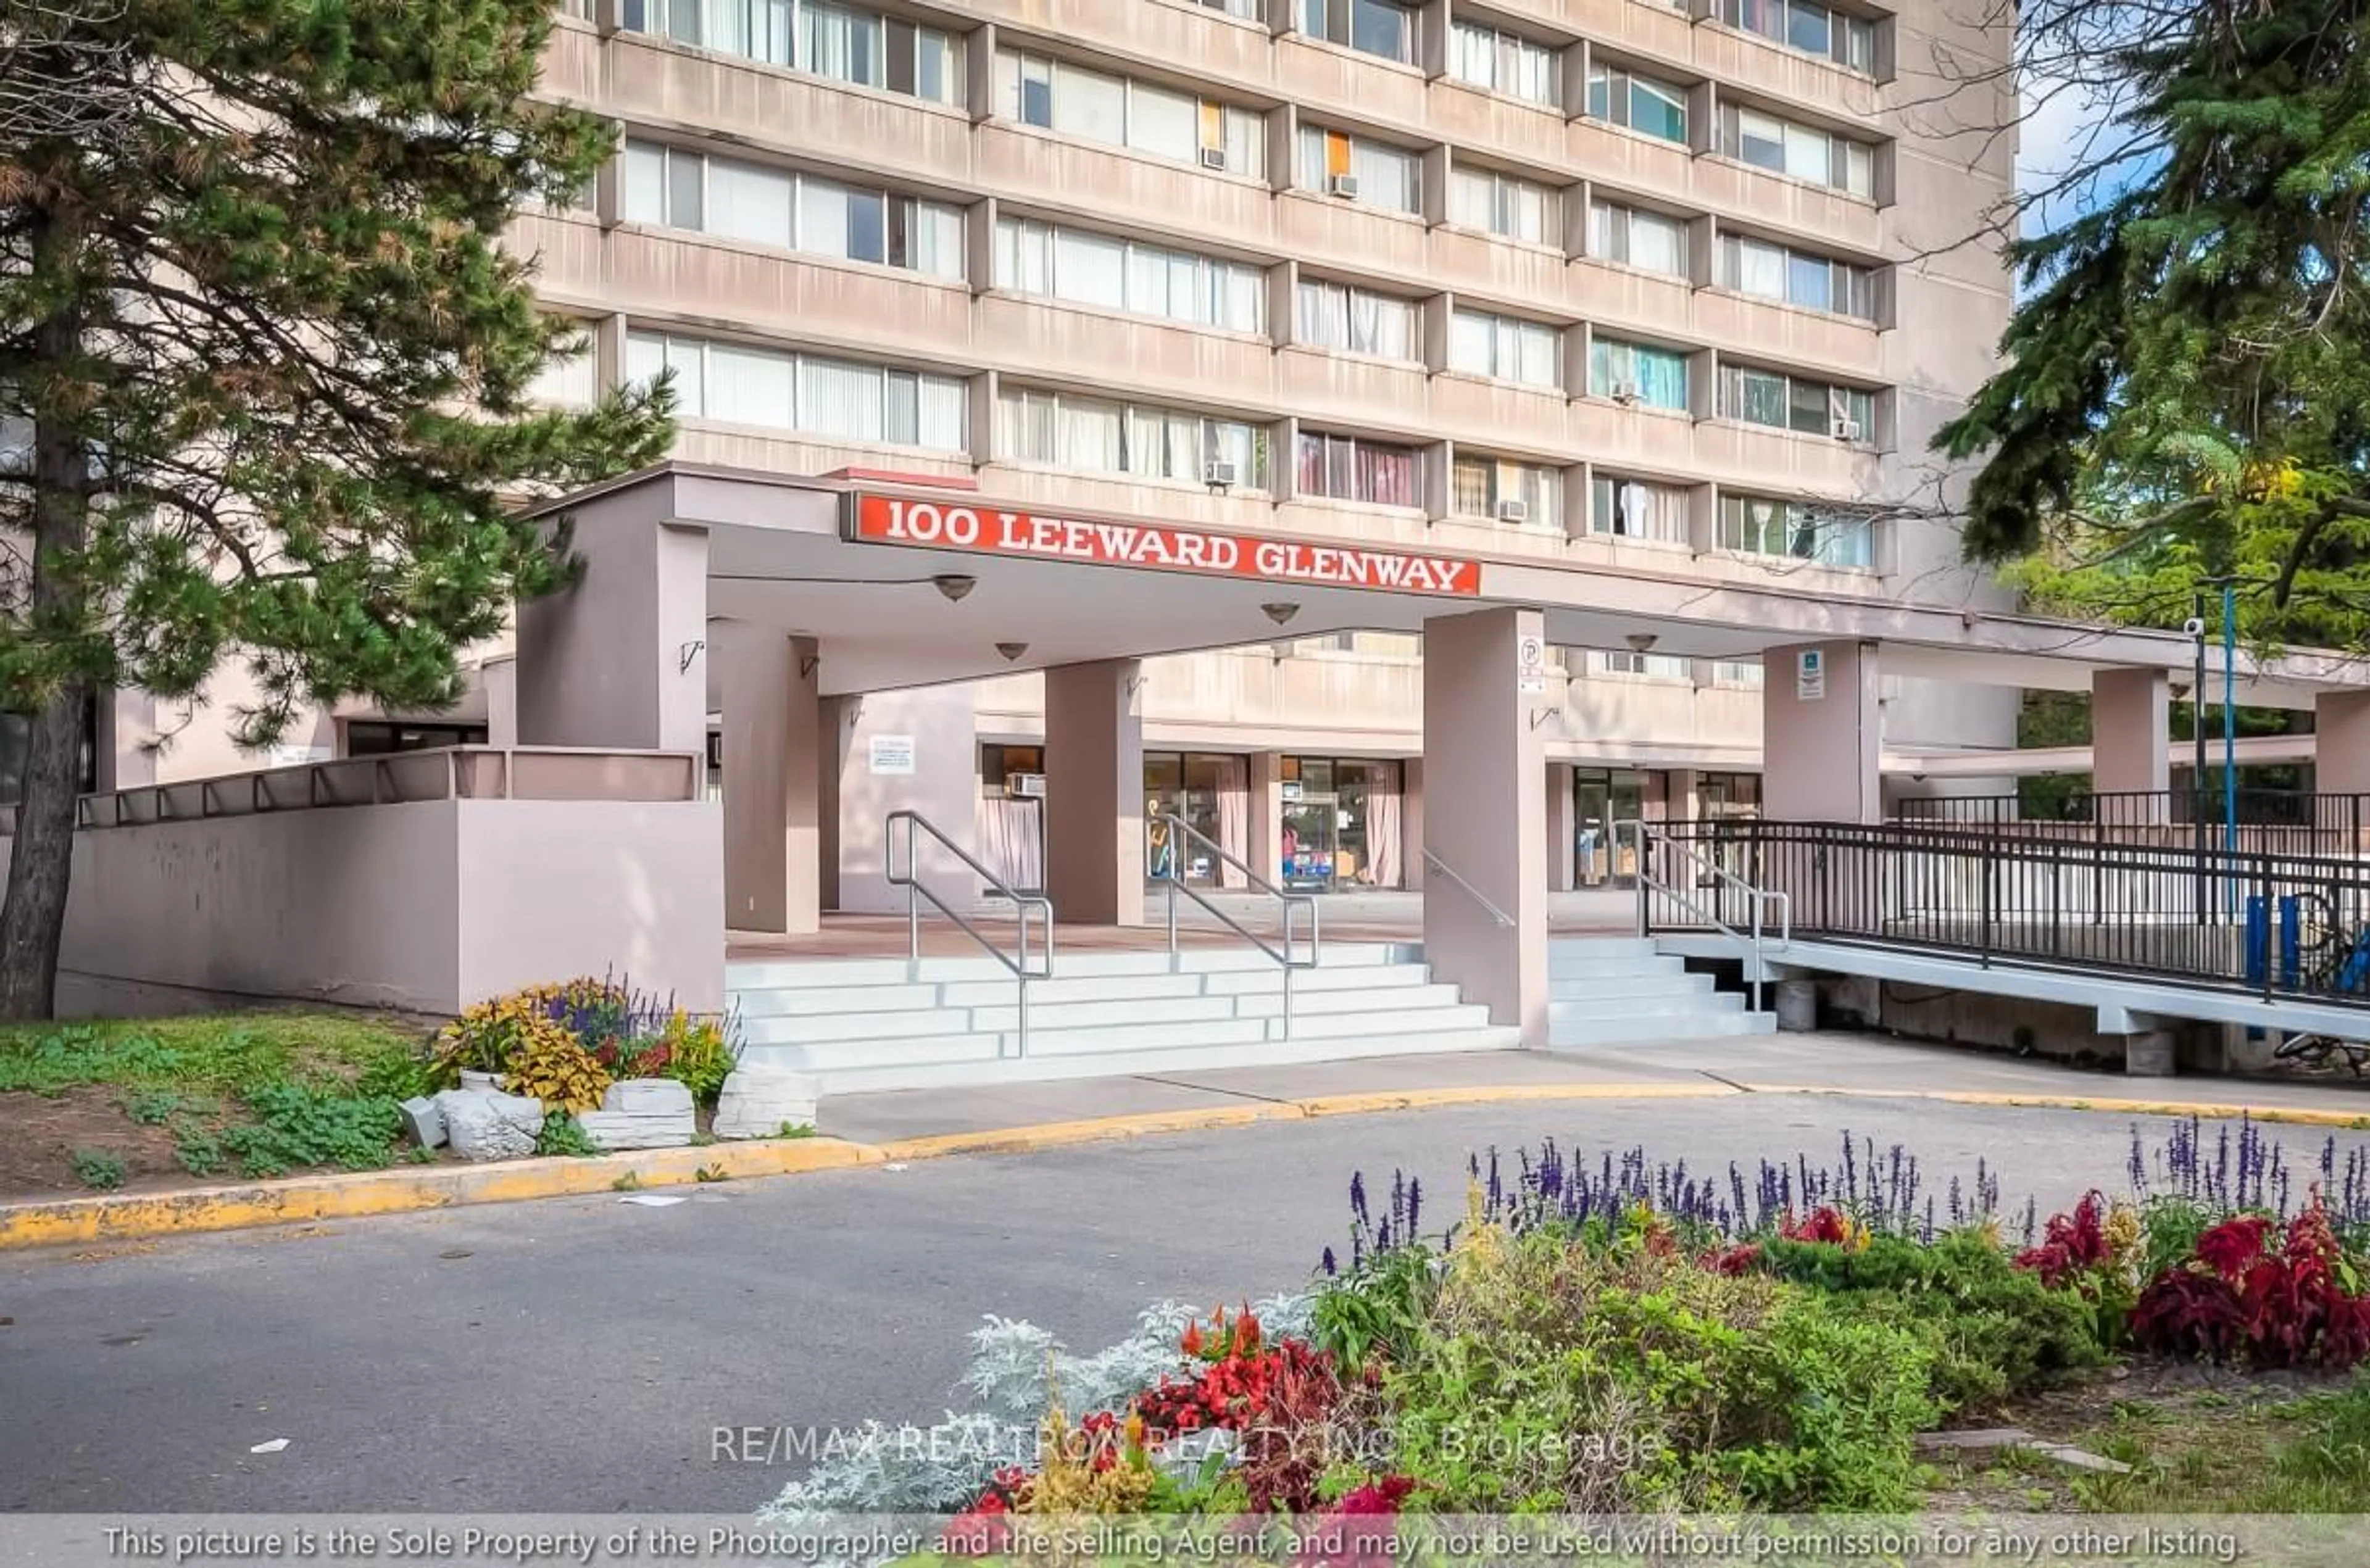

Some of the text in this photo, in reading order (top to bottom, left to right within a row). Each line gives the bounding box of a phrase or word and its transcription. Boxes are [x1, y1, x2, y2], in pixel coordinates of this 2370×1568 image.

[886, 501, 1466, 591] 100 LEEWARD GLENWAY
